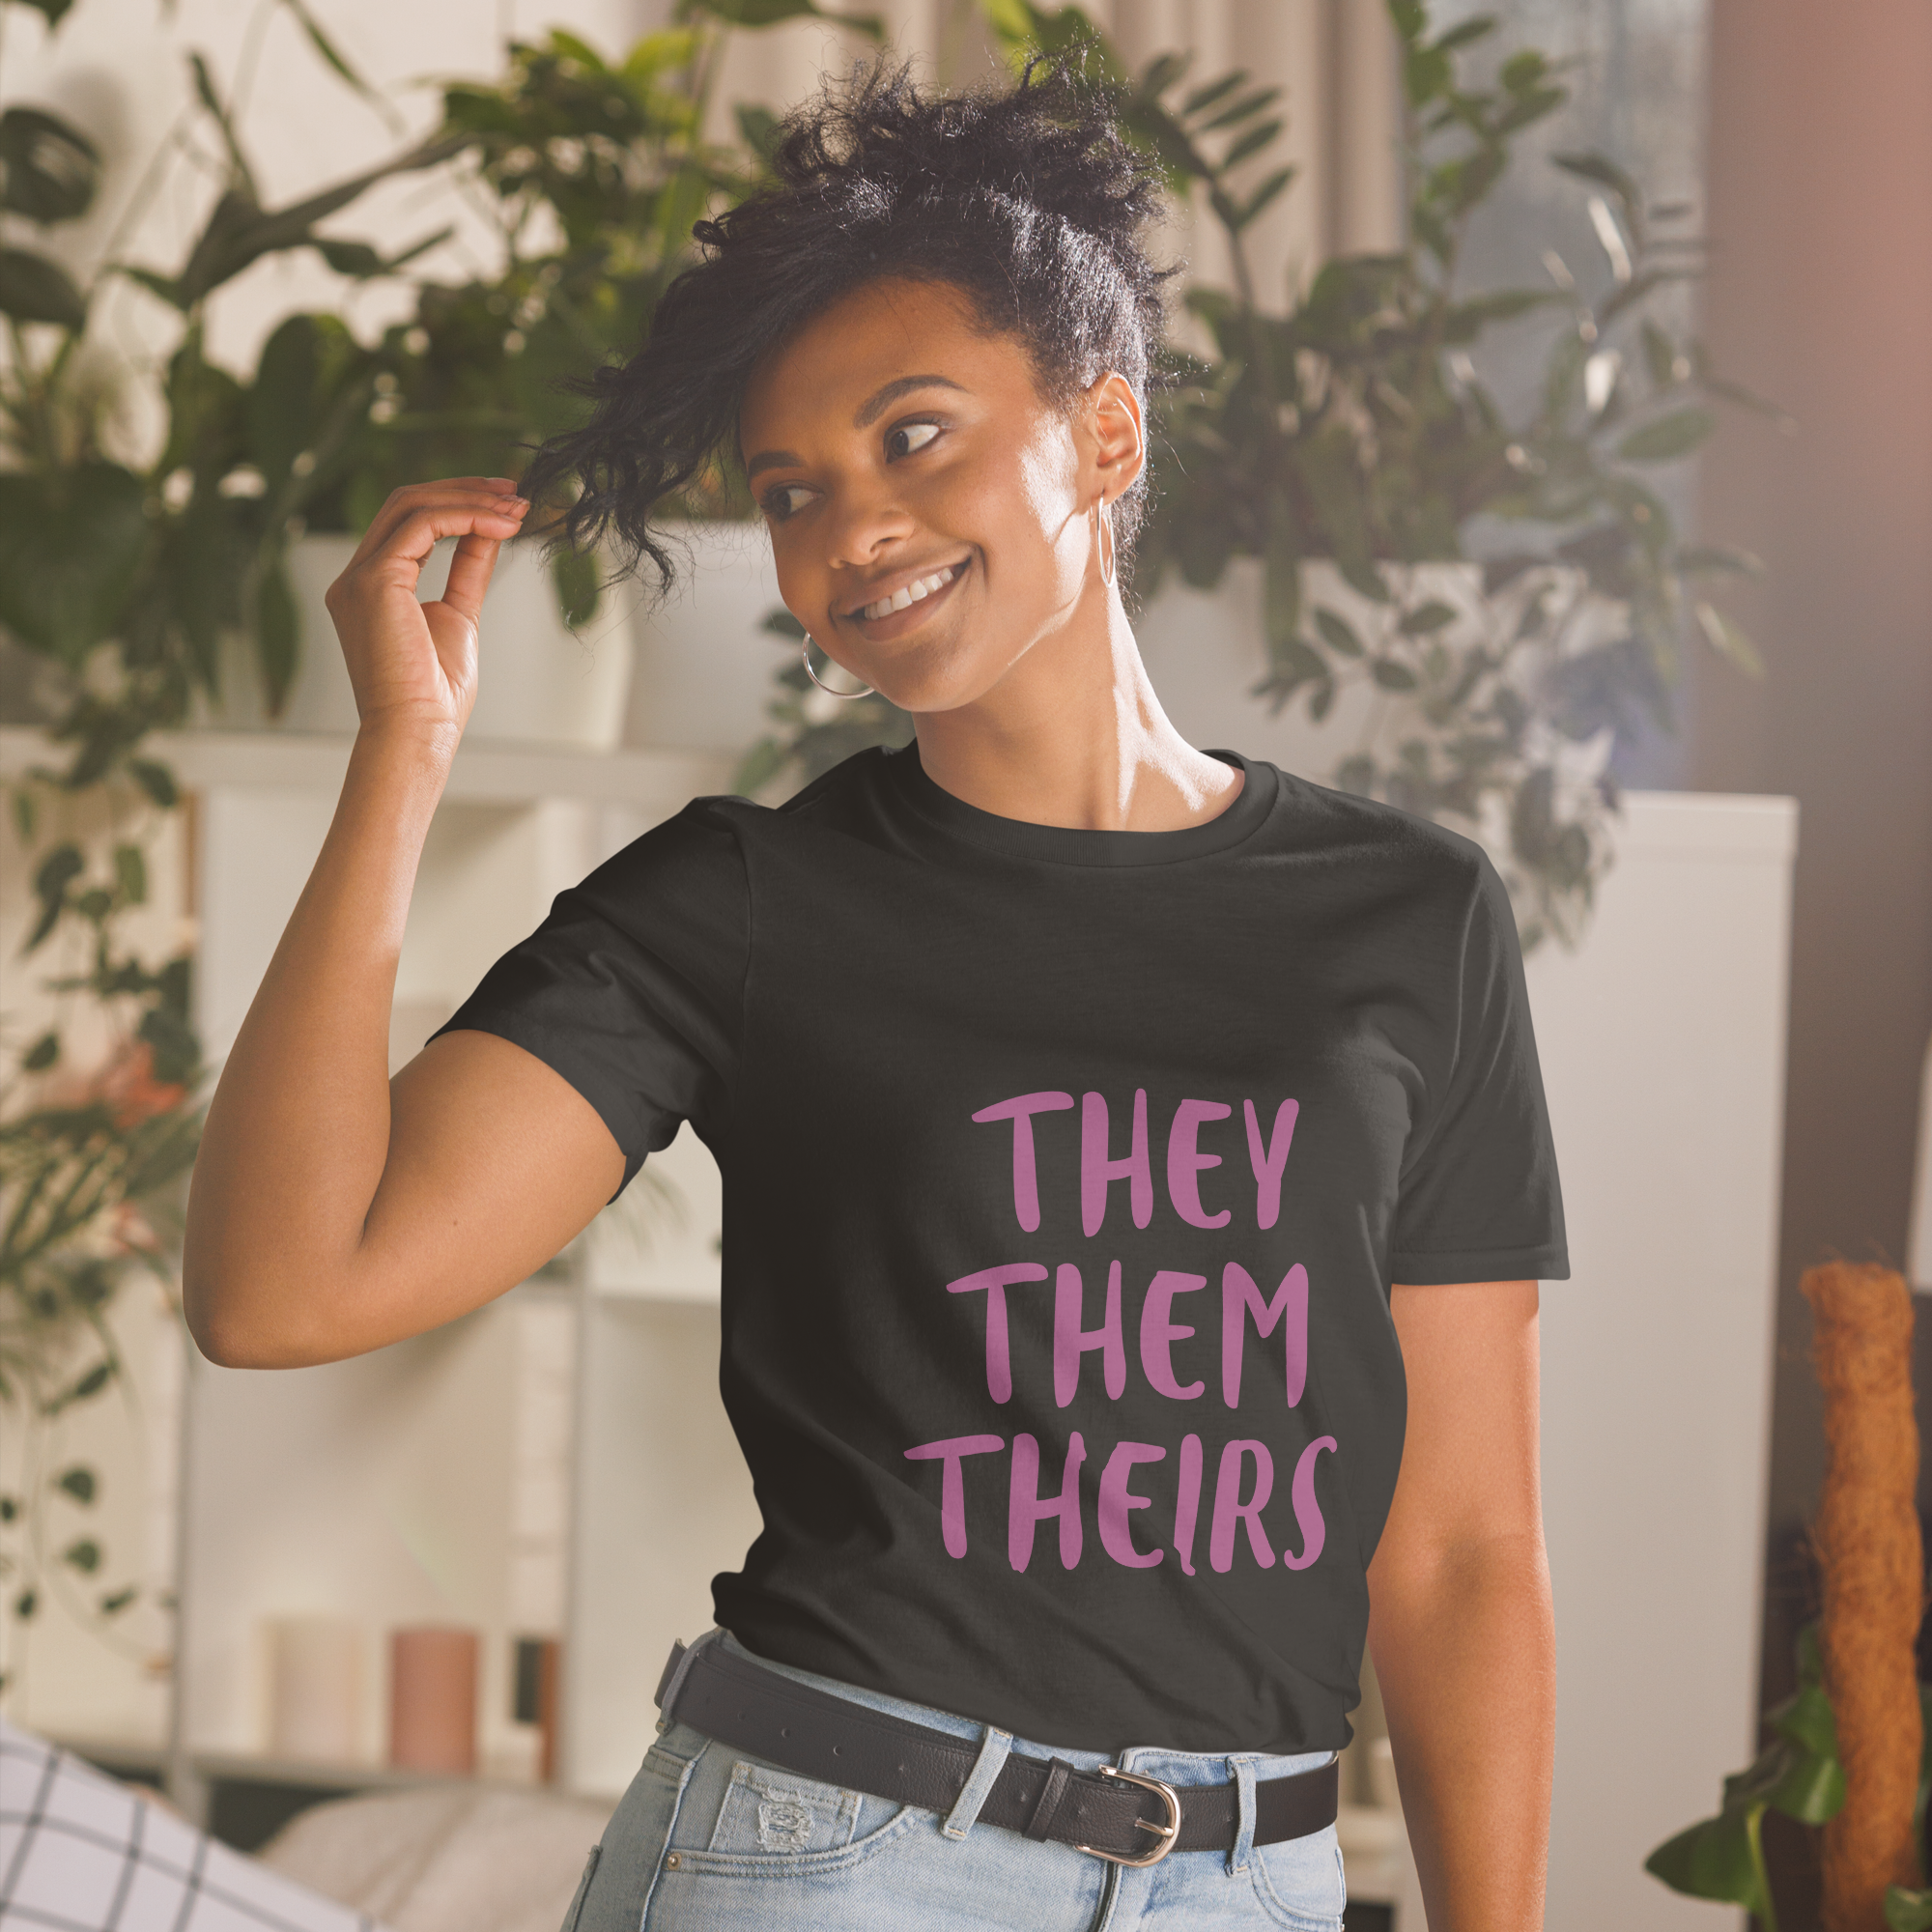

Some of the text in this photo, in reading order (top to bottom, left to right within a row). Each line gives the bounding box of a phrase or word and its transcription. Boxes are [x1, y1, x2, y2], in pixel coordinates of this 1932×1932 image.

[971, 1088, 1299, 1237] THEY
[946, 1260, 1309, 1409] THEM
[903, 1431, 1338, 1577] THEIRS
